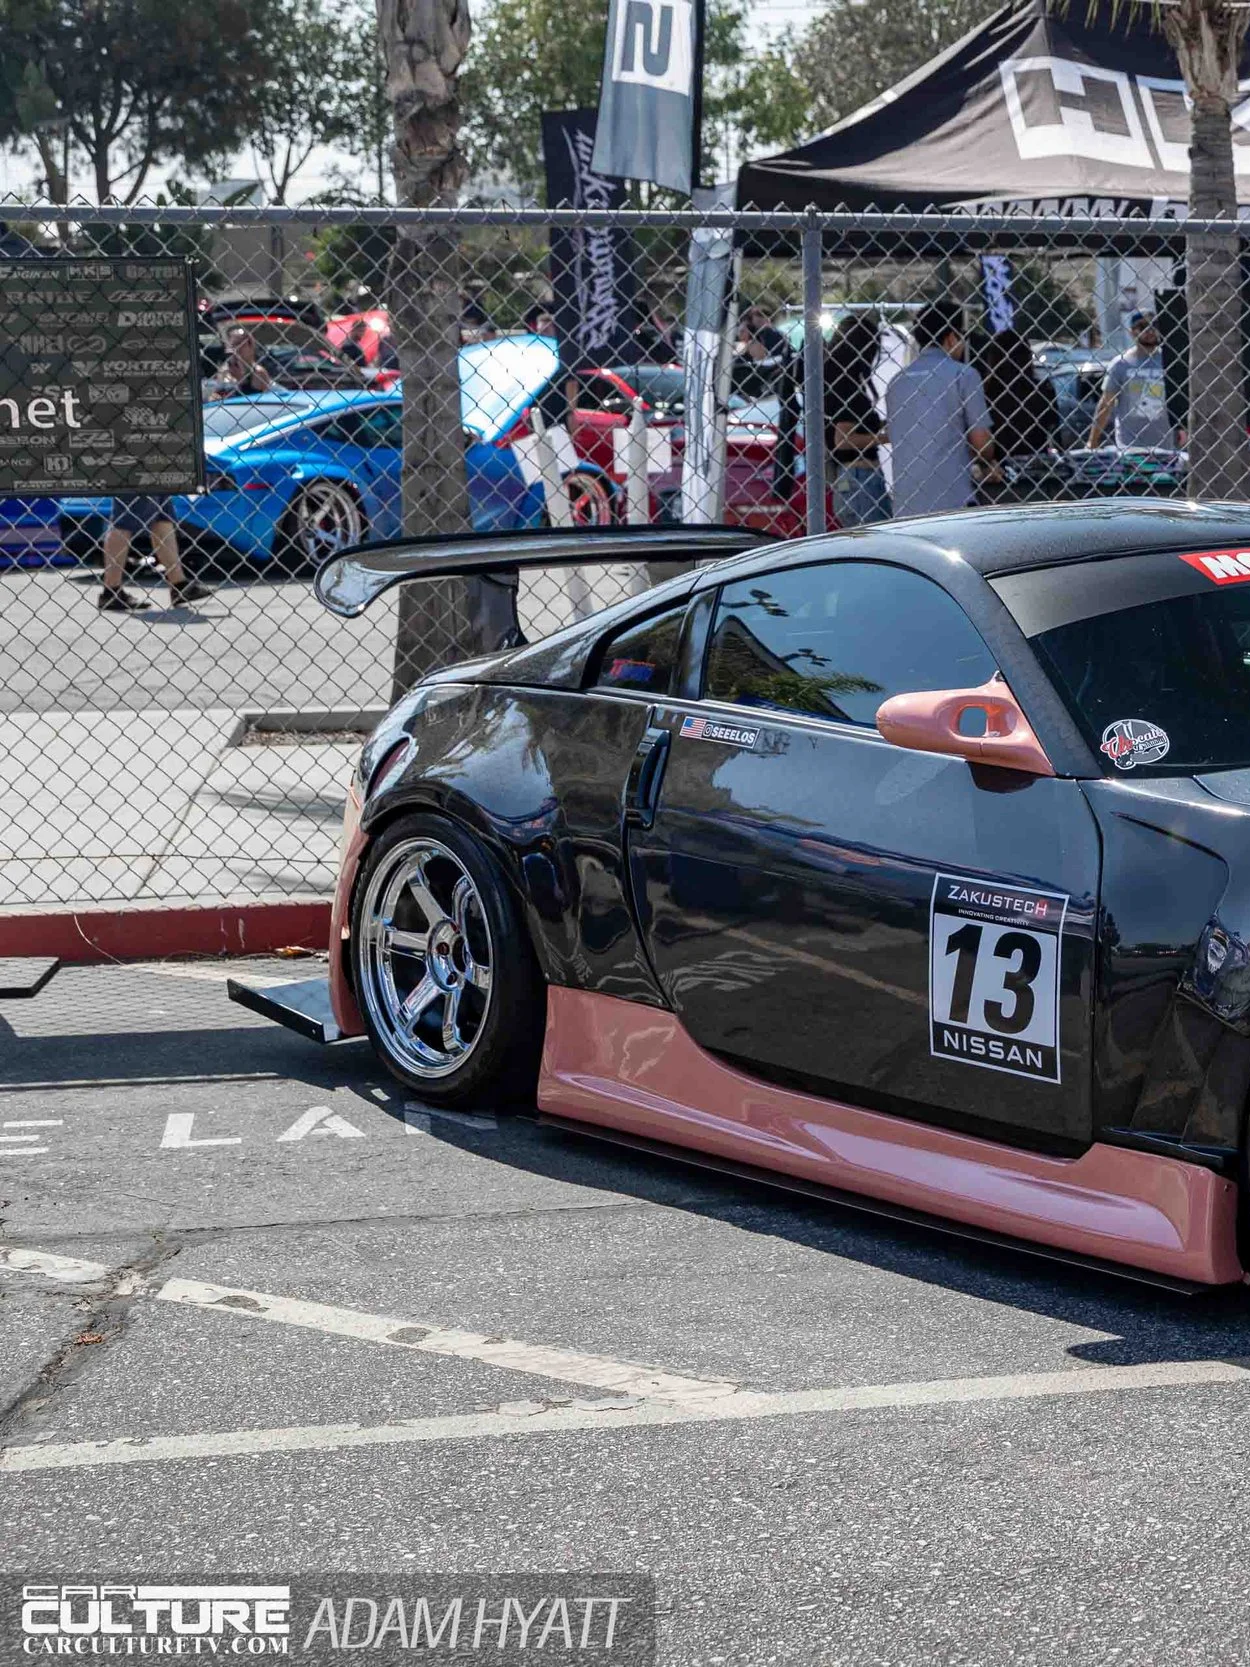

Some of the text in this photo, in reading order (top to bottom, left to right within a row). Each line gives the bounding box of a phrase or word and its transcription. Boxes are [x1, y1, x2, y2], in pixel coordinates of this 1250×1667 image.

[947, 885, 1048, 917] ZAKUSTECH
[958, 908, 994, 921] INNOVATING
[945, 923, 1042, 1035] 13
[943, 1029, 1042, 1069] NISSAN
